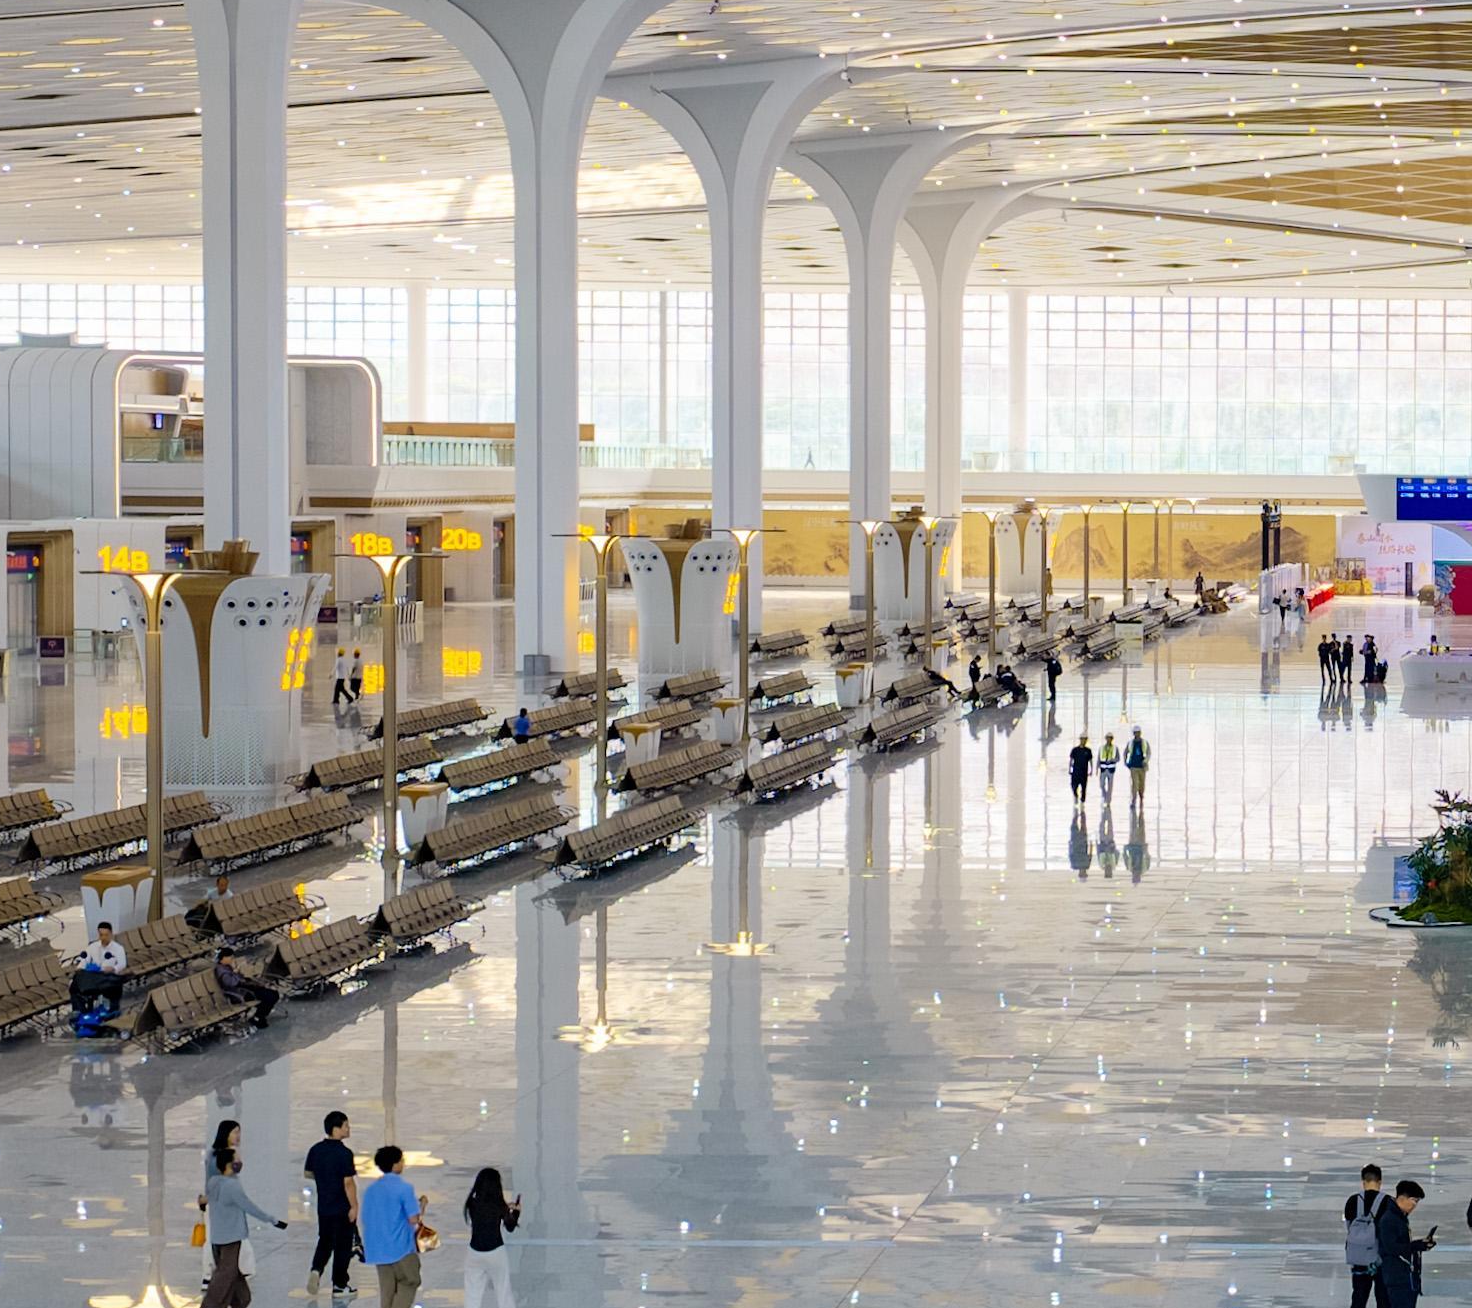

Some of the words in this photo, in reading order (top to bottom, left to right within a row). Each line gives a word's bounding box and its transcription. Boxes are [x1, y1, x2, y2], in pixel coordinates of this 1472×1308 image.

[350, 532, 394, 556] 18B
[441, 527, 483, 551] 20B
[98, 546, 150, 573] 14B
